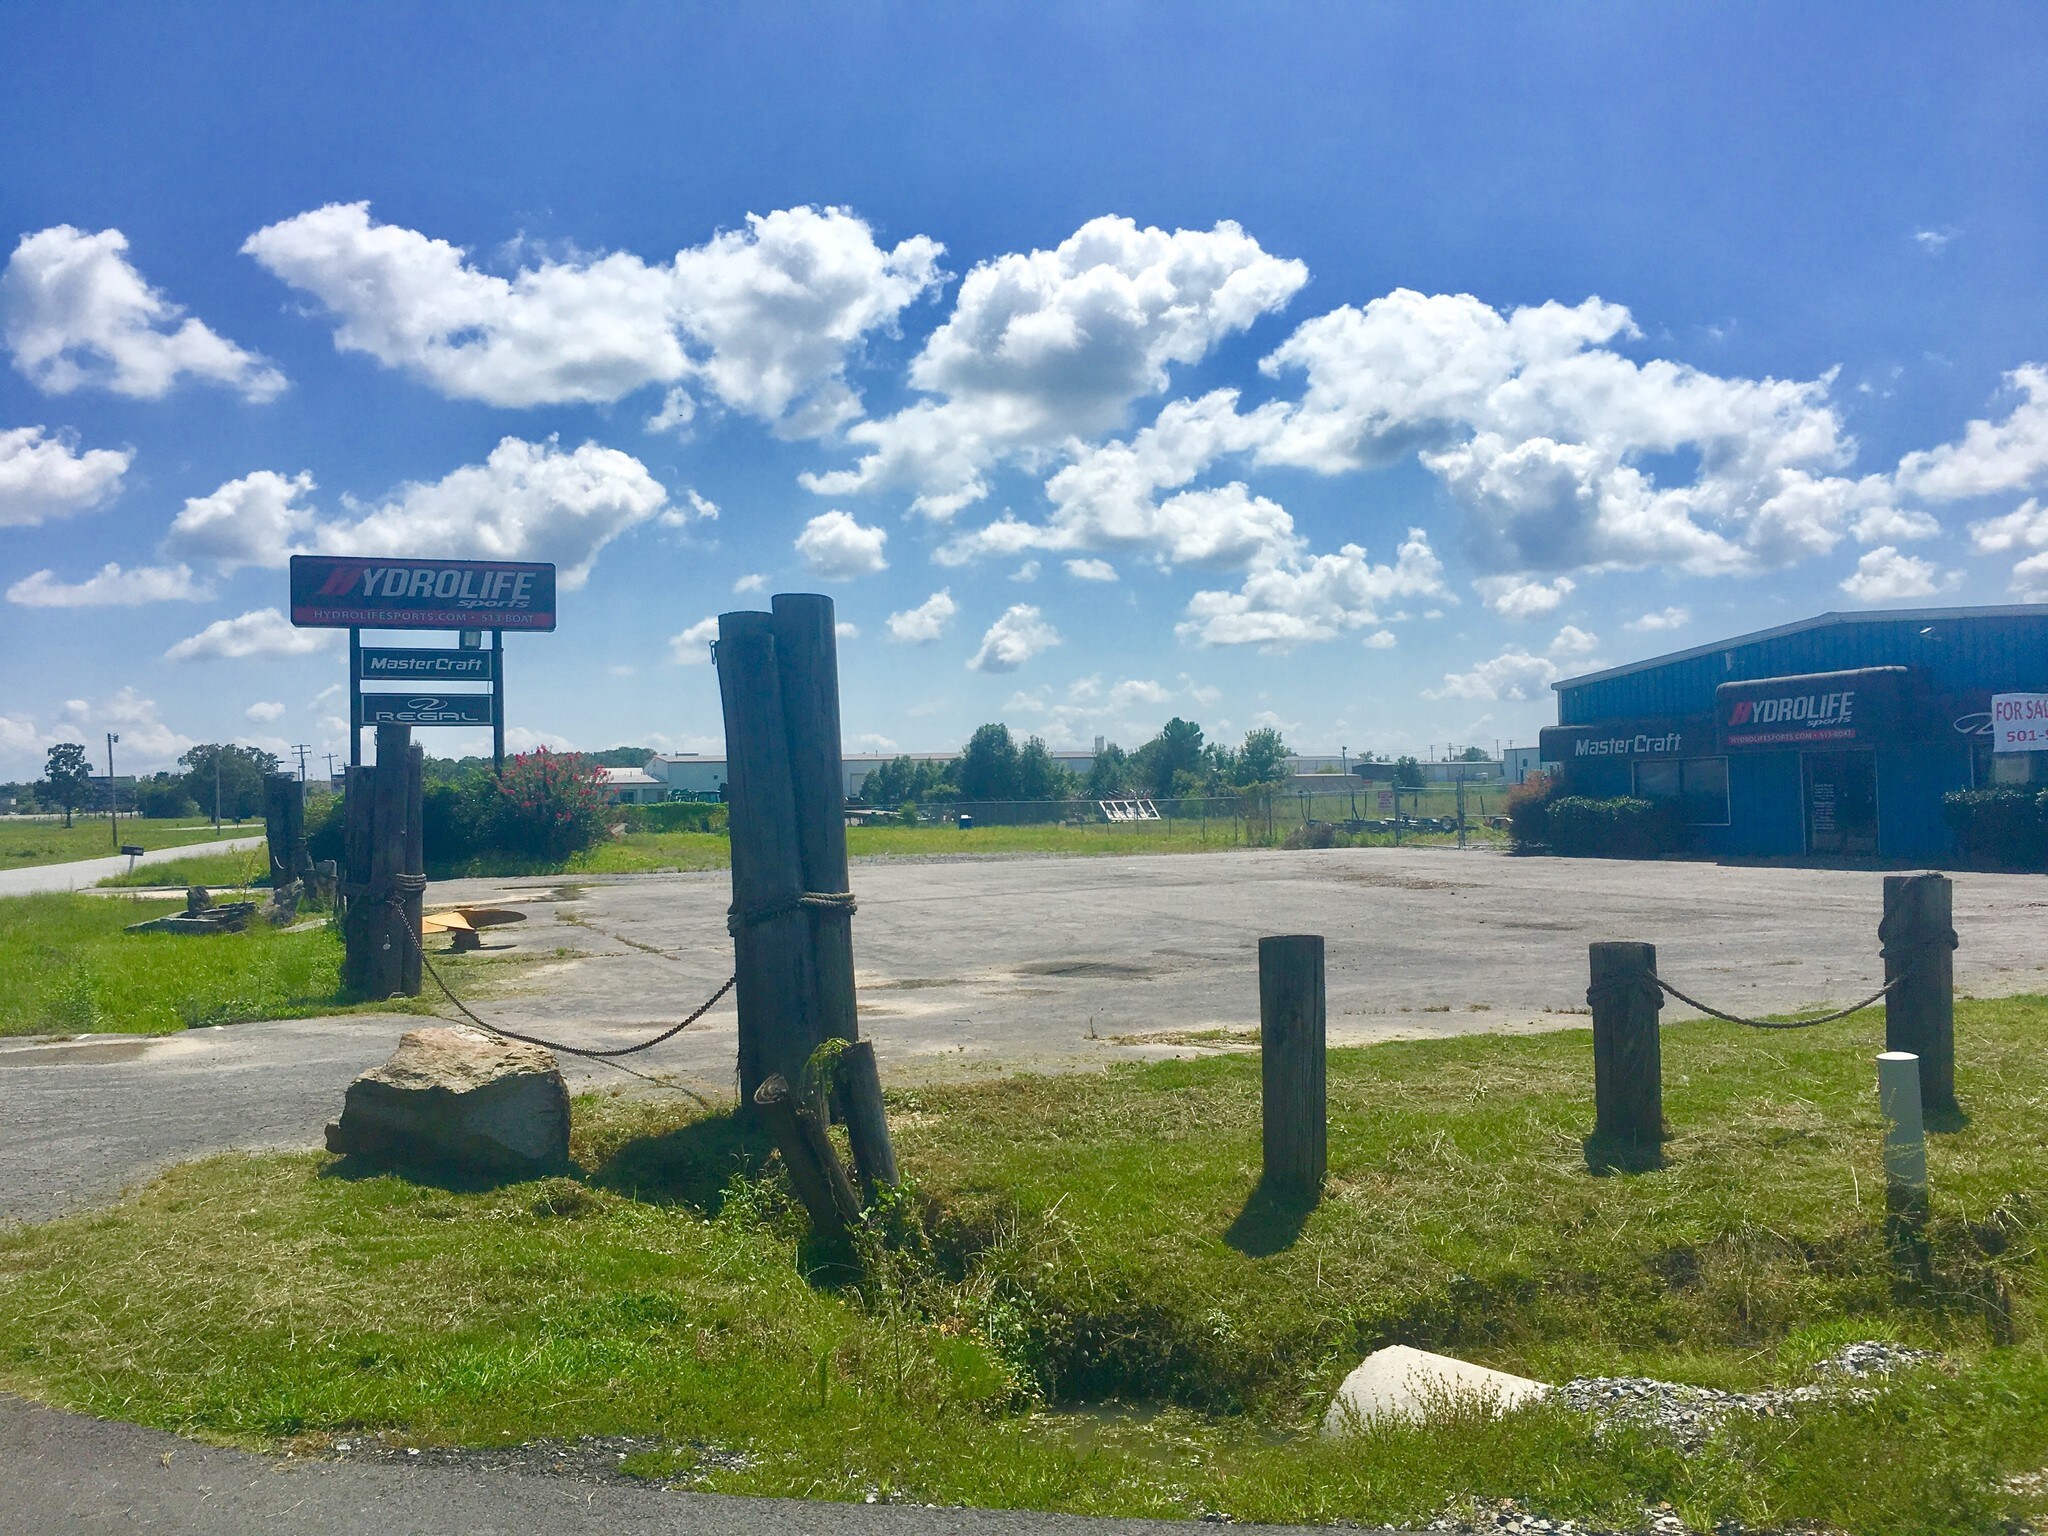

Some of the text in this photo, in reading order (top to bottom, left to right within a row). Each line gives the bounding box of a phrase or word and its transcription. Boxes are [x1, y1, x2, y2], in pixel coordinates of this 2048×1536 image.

[457, 599, 530, 609] sports
[314, 610, 534, 623] HYDROLIFESPORTS.COM 513-BOAT
[371, 657, 482, 671] MasterCraft
[375, 711, 479, 721] REGAL
[1996, 701, 2023, 721] FOR
[1806, 716, 1852, 728] sports
[1731, 730, 1851, 743] HYDROLIFESPORTS.COM 513-BOAT
[2007, 730, 2048, 742] 501-
[1575, 733, 1681, 756] MasterCraft
